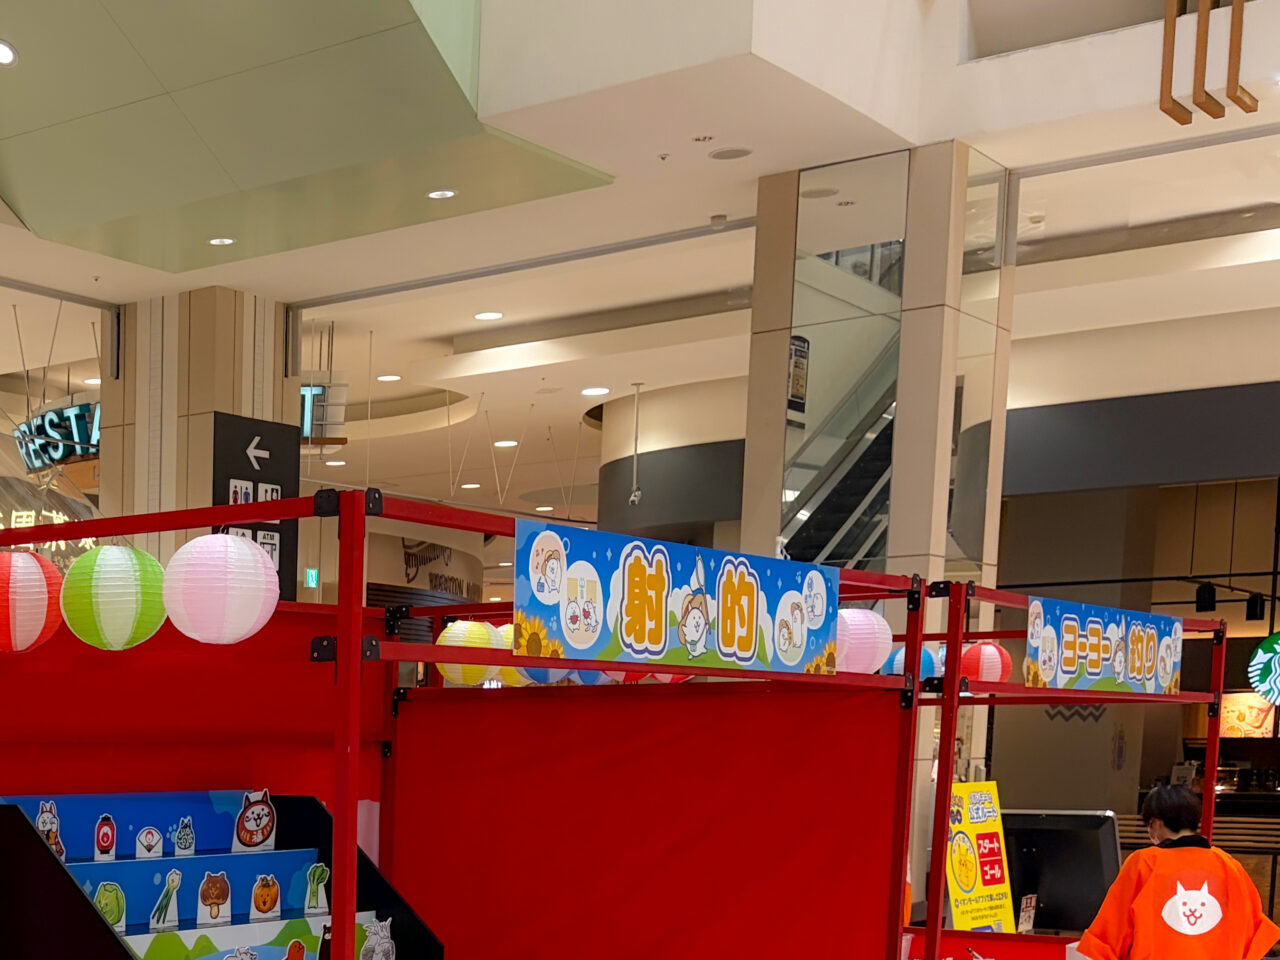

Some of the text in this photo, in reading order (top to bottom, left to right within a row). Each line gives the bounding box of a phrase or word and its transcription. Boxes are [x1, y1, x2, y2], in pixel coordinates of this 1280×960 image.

[262, 532, 275, 541] ATM
[978, 838, 1000, 854] スタート
[983, 864, 1002, 880] ゴール
